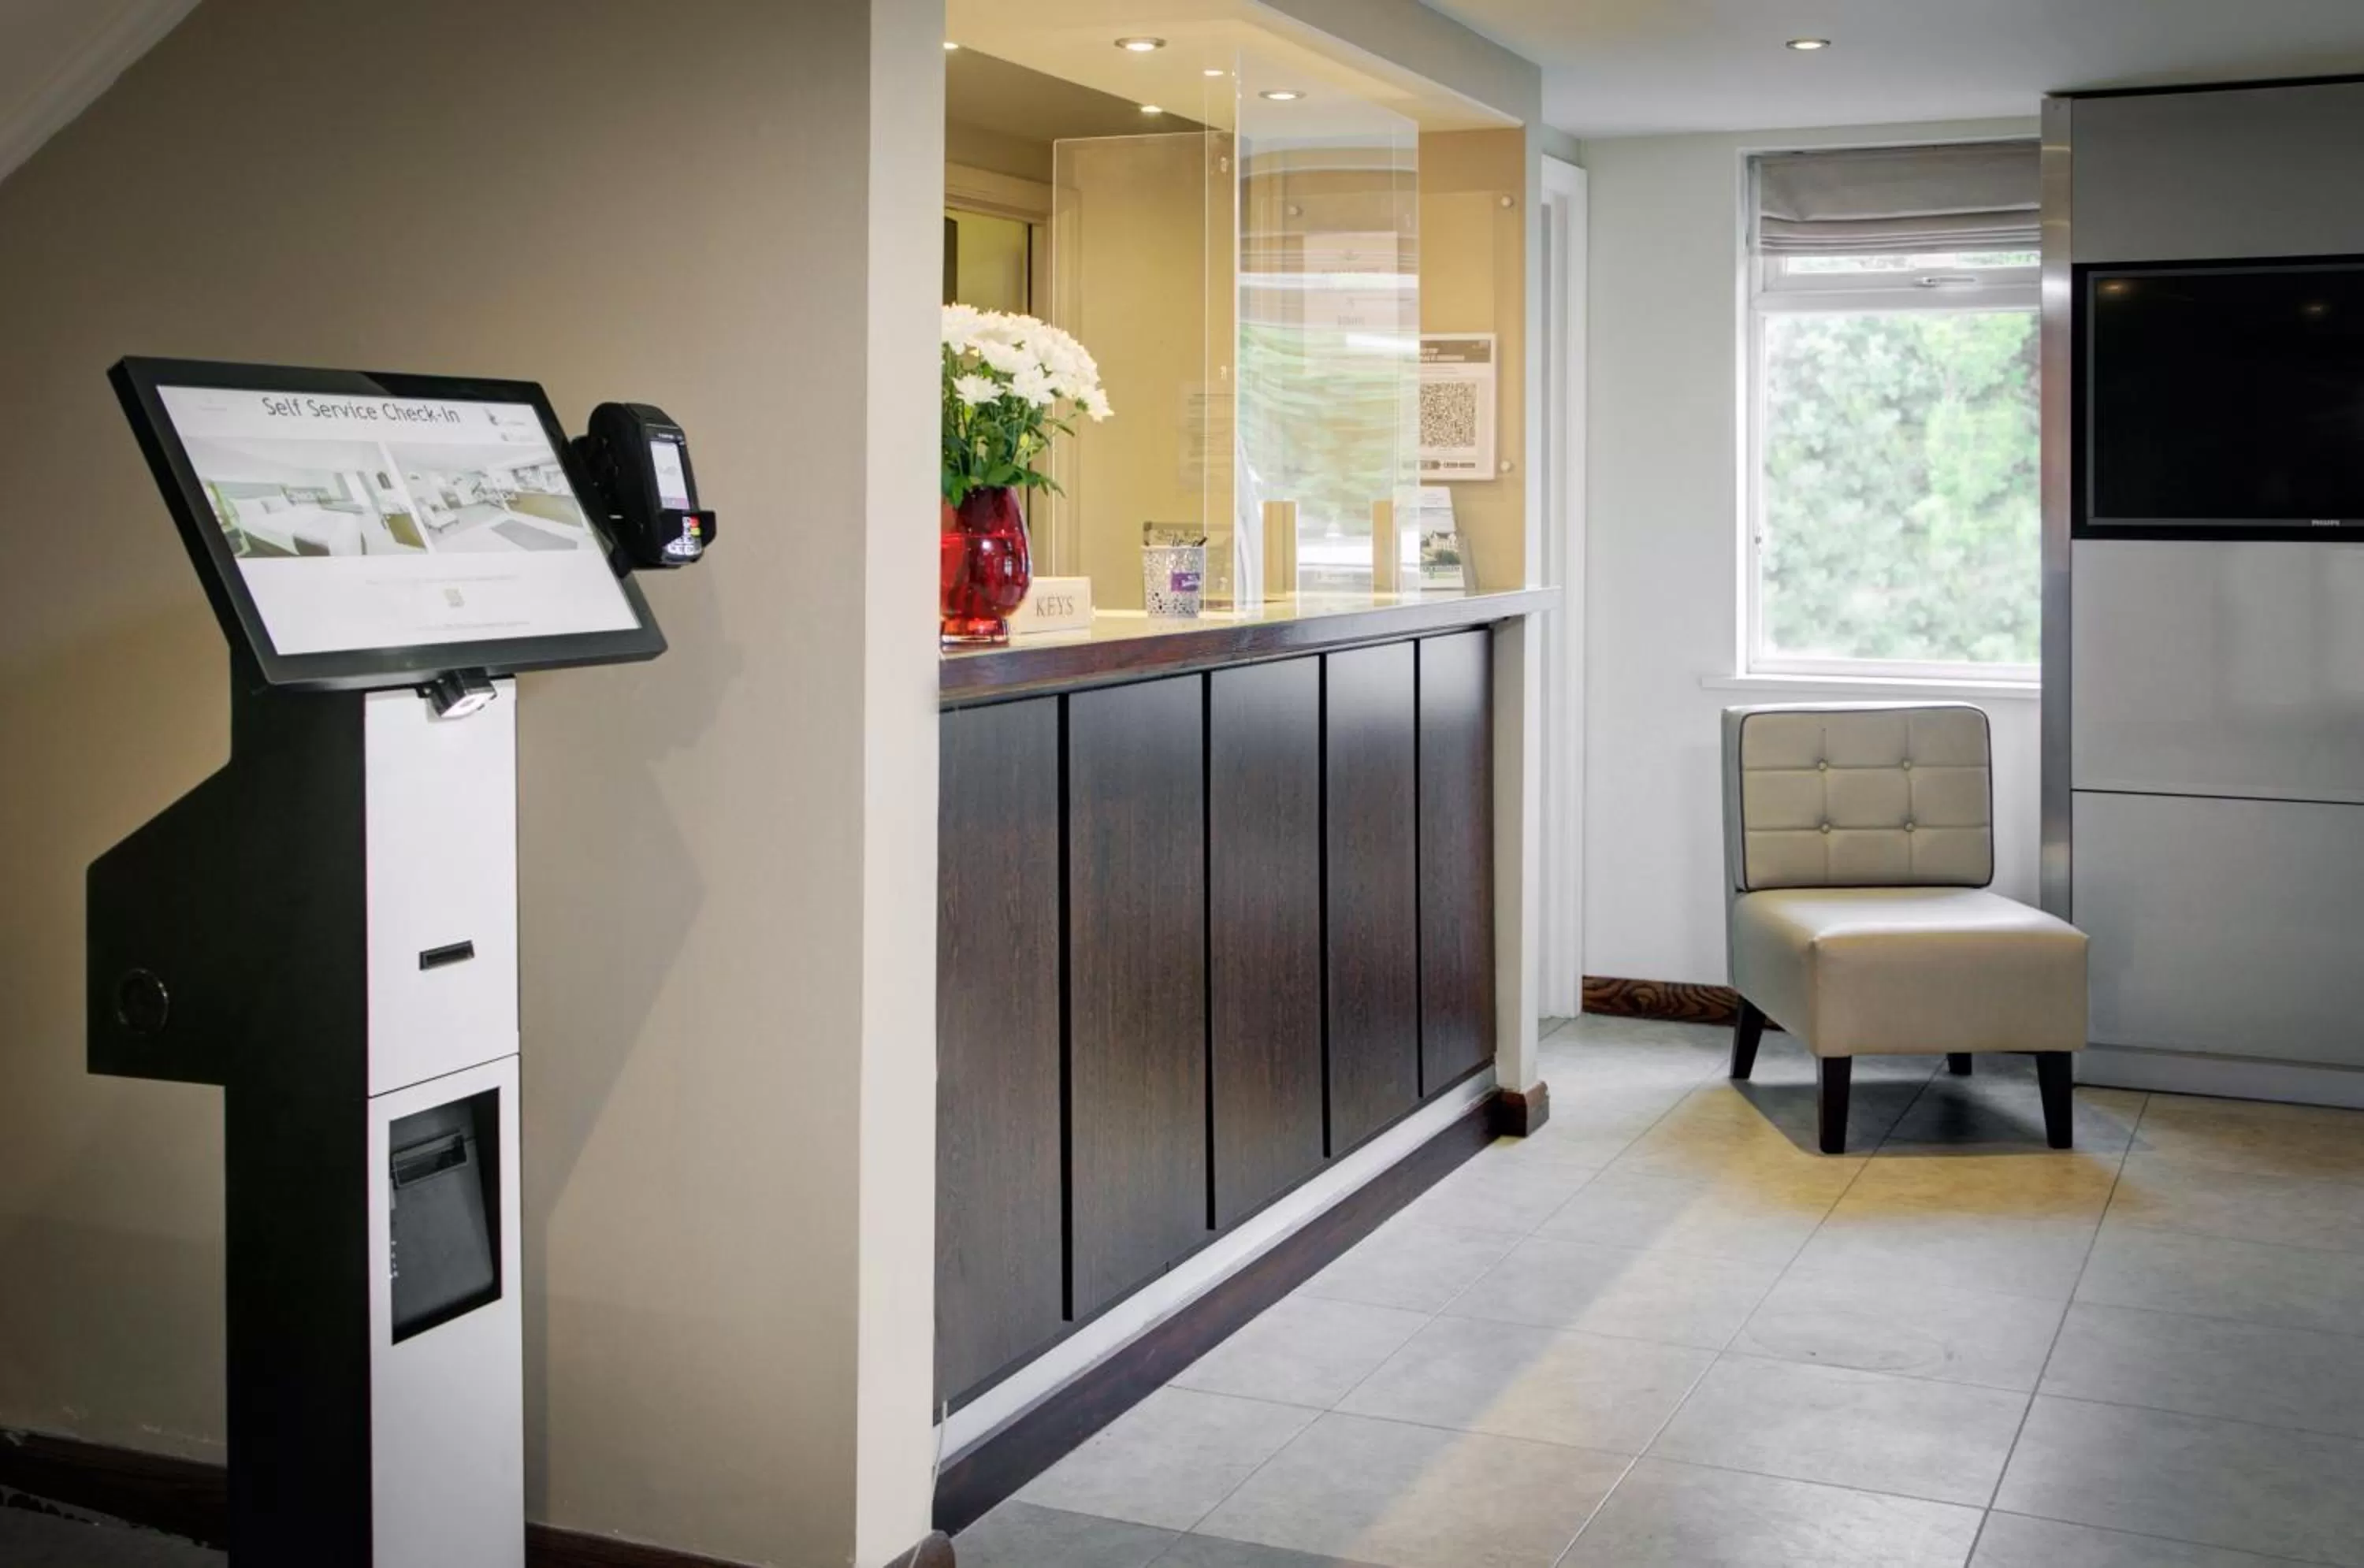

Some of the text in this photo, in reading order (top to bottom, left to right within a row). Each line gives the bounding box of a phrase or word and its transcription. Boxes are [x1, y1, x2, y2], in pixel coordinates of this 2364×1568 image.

[262, 397, 461, 424] Self Service Check-In
[1035, 596, 1074, 619] KEYS
